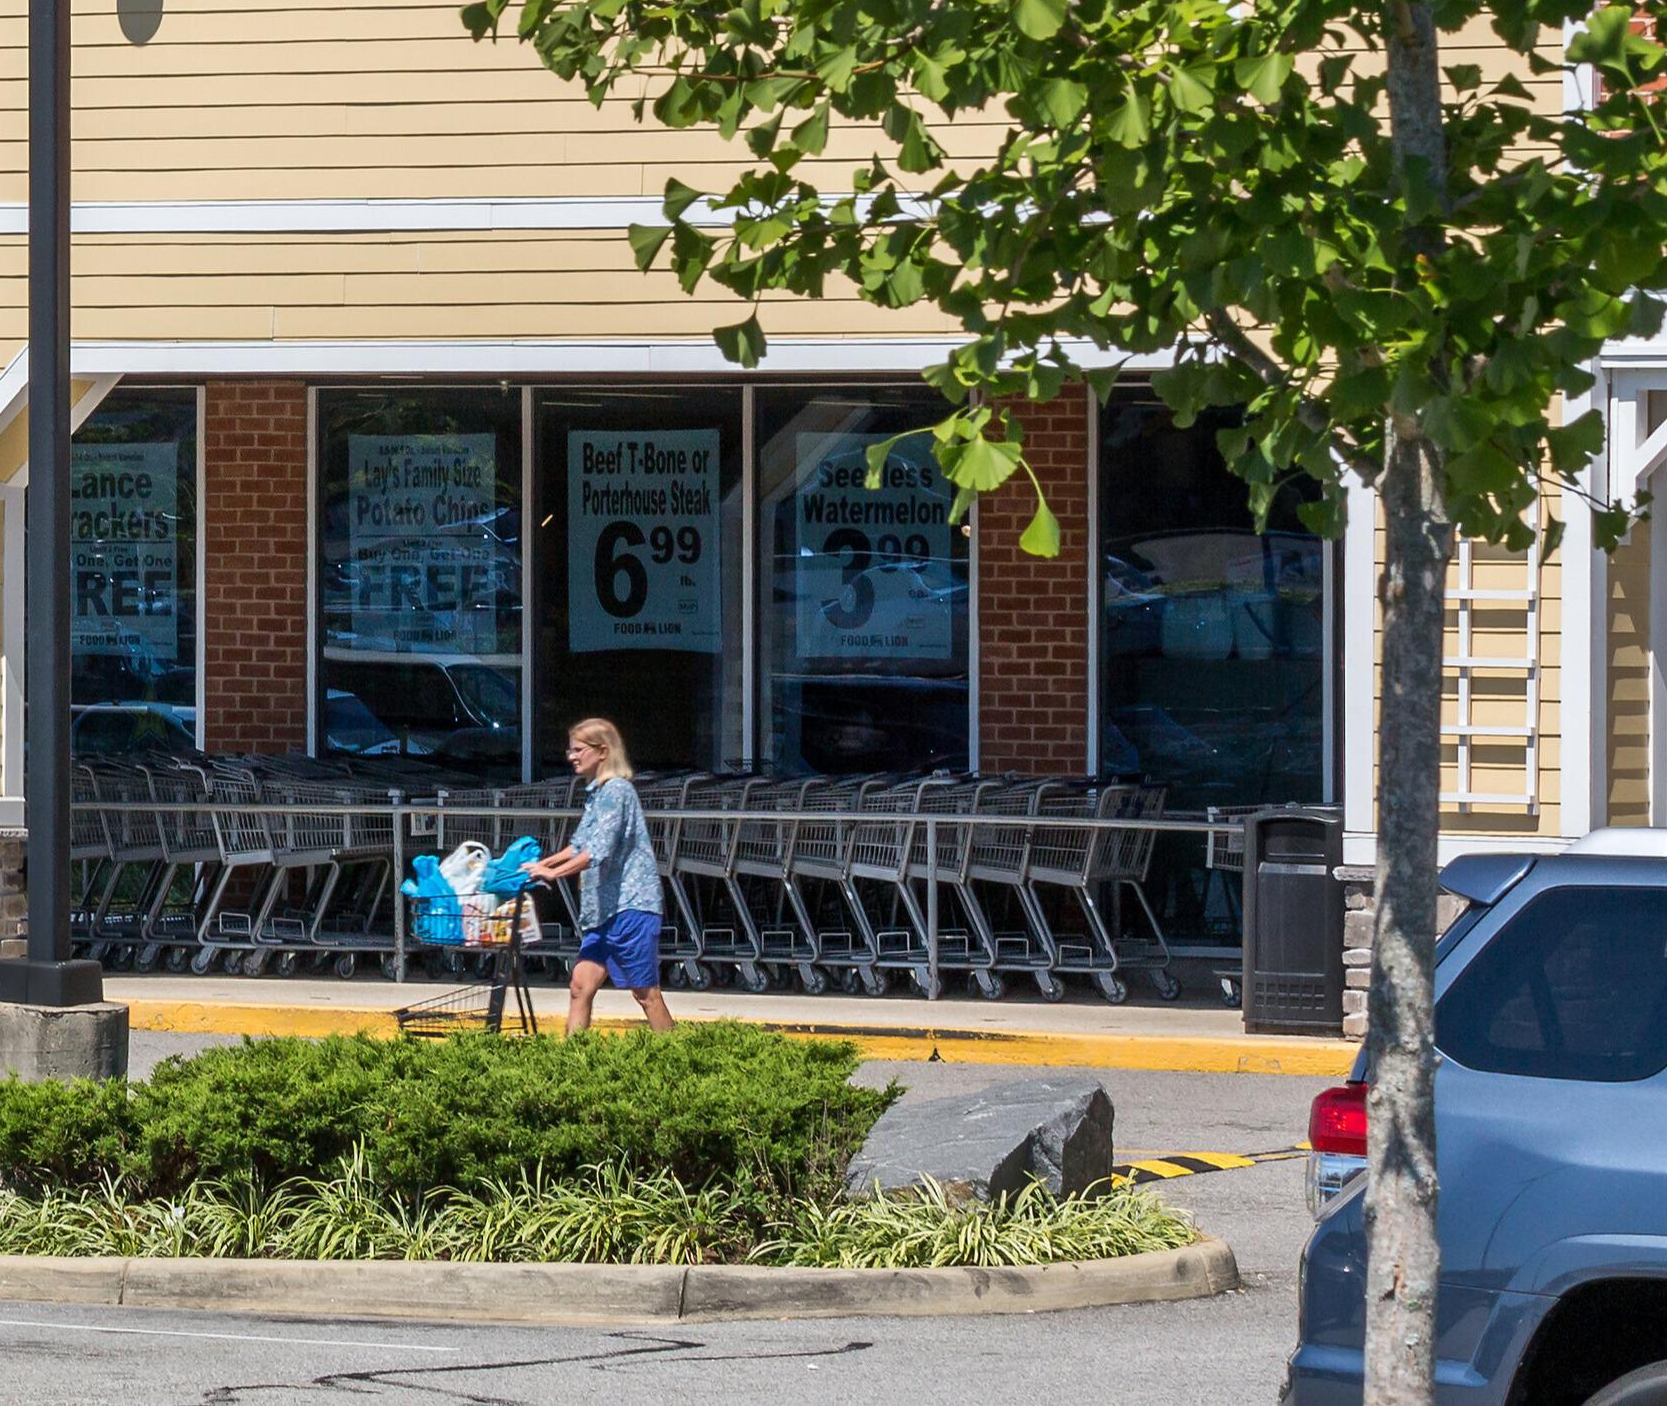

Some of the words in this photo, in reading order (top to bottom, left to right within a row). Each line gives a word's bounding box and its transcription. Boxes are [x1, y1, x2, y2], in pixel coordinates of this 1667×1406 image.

[365, 459, 400, 495] Lay's
[404, 457, 450, 496] Family
[453, 457, 482, 487] Size
[583, 441, 623, 474] Beef
[627, 441, 687, 475] T-Bone
[692, 450, 709, 474] or
[819, 459, 933, 489] Seeless
[356, 494, 426, 526] Potato
[432, 494, 490, 532] Chips
[582, 480, 666, 516] Porterhouse
[670, 479, 711, 516] Steak
[803, 495, 946, 525] Watermelon
[71, 501, 170, 539] rackers
[114, 553, 139, 567] Get
[144, 554, 173, 567] One
[593, 520, 648, 619] 6
[650, 525, 702, 564] 99
[77, 571, 173, 616] REE
[359, 565, 491, 611] FREE
[613, 622, 642, 635] FOOD
[658, 622, 682, 635] LION
[840, 635, 869, 647] FOOD
[884, 635, 908, 647] LION
